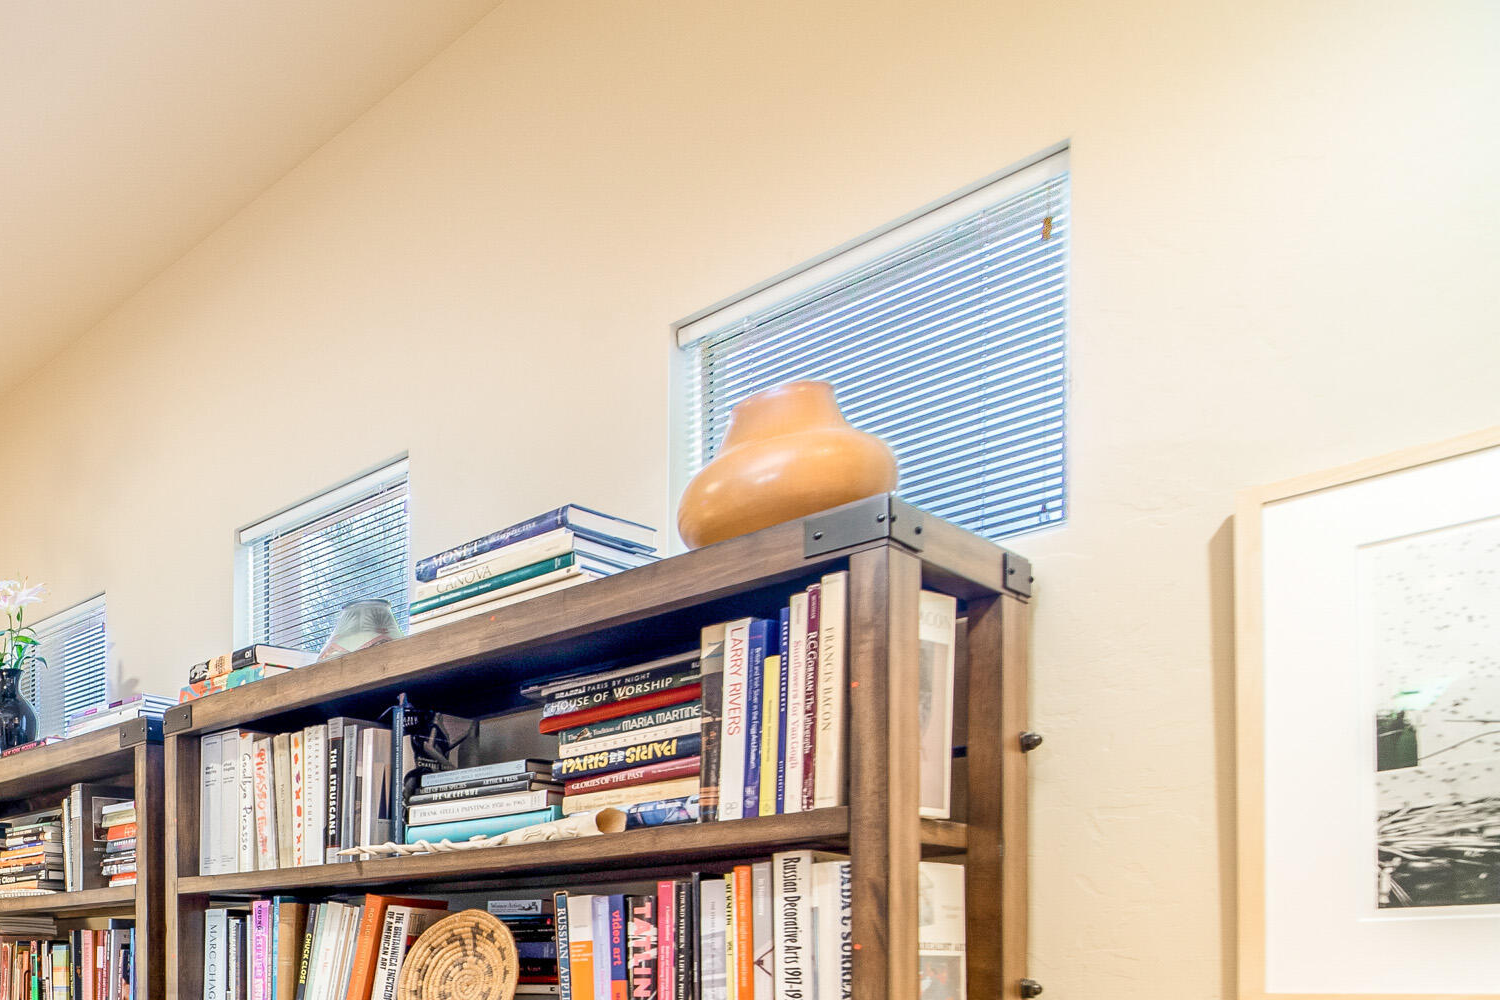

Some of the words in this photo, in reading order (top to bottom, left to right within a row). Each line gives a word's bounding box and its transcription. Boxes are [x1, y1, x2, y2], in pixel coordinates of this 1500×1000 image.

[436, 566, 492, 594] CANOVA
[730, 626, 744, 676] LARRY
[823, 626, 835, 682] FRANCIS
[551, 695, 589, 712] HOUSE
[593, 691, 609, 702] OF
[613, 677, 673, 700] WORSHIP
[728, 683, 742, 736] RIVERS
[822, 687, 833, 732] BACON
[622, 715, 654, 731] MARIA
[655, 704, 701, 724] MARTINE
[562, 752, 609, 774] PARIS
[571, 777, 600, 790] GLORIES
[612, 773, 626, 782] THE
[329, 774, 337, 836] ETRUSCANS
[783, 857, 802, 893] Russian
[387, 911, 394, 920] OF
[395, 912, 404, 924] THE
[612, 910, 622, 943] video
[783, 896, 802, 943] Decorative
[209, 924, 217, 959] MARC
[302, 933, 311, 960] CHUCK
[382, 921, 392, 956] AMERICAN
[389, 926, 402, 967] BRITANNICA
[558, 908, 568, 959] RUSSIAN
[633, 902, 651, 998] TATLIN
[380, 957, 388, 970] ART
[613, 947, 622, 966] art
[784, 945, 802, 963] Arts
[299, 961, 308, 984] CLOSE
